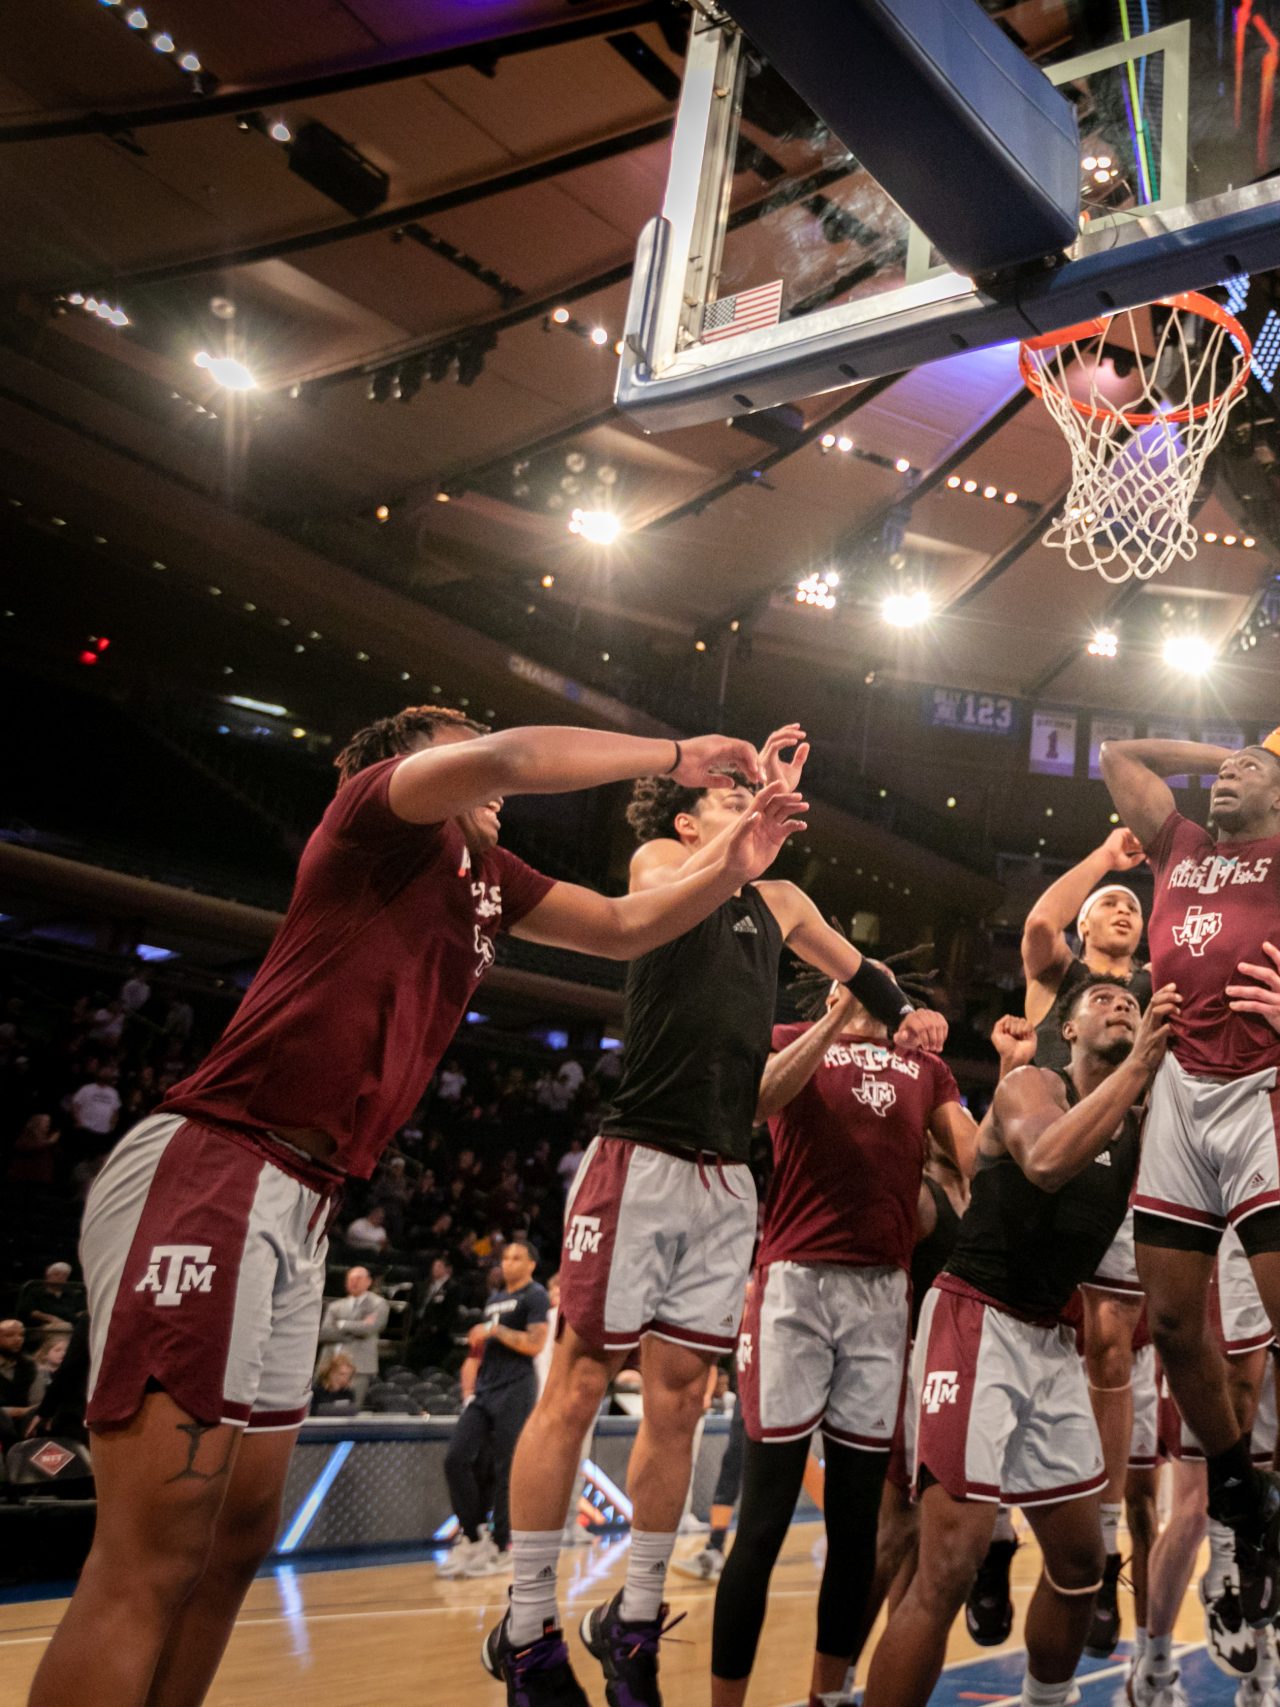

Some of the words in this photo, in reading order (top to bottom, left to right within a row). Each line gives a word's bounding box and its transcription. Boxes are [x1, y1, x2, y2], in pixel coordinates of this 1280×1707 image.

[963, 694, 1012, 728] 123
[1046, 730, 1060, 759] 1
[134, 1244, 217, 1307] ATM
